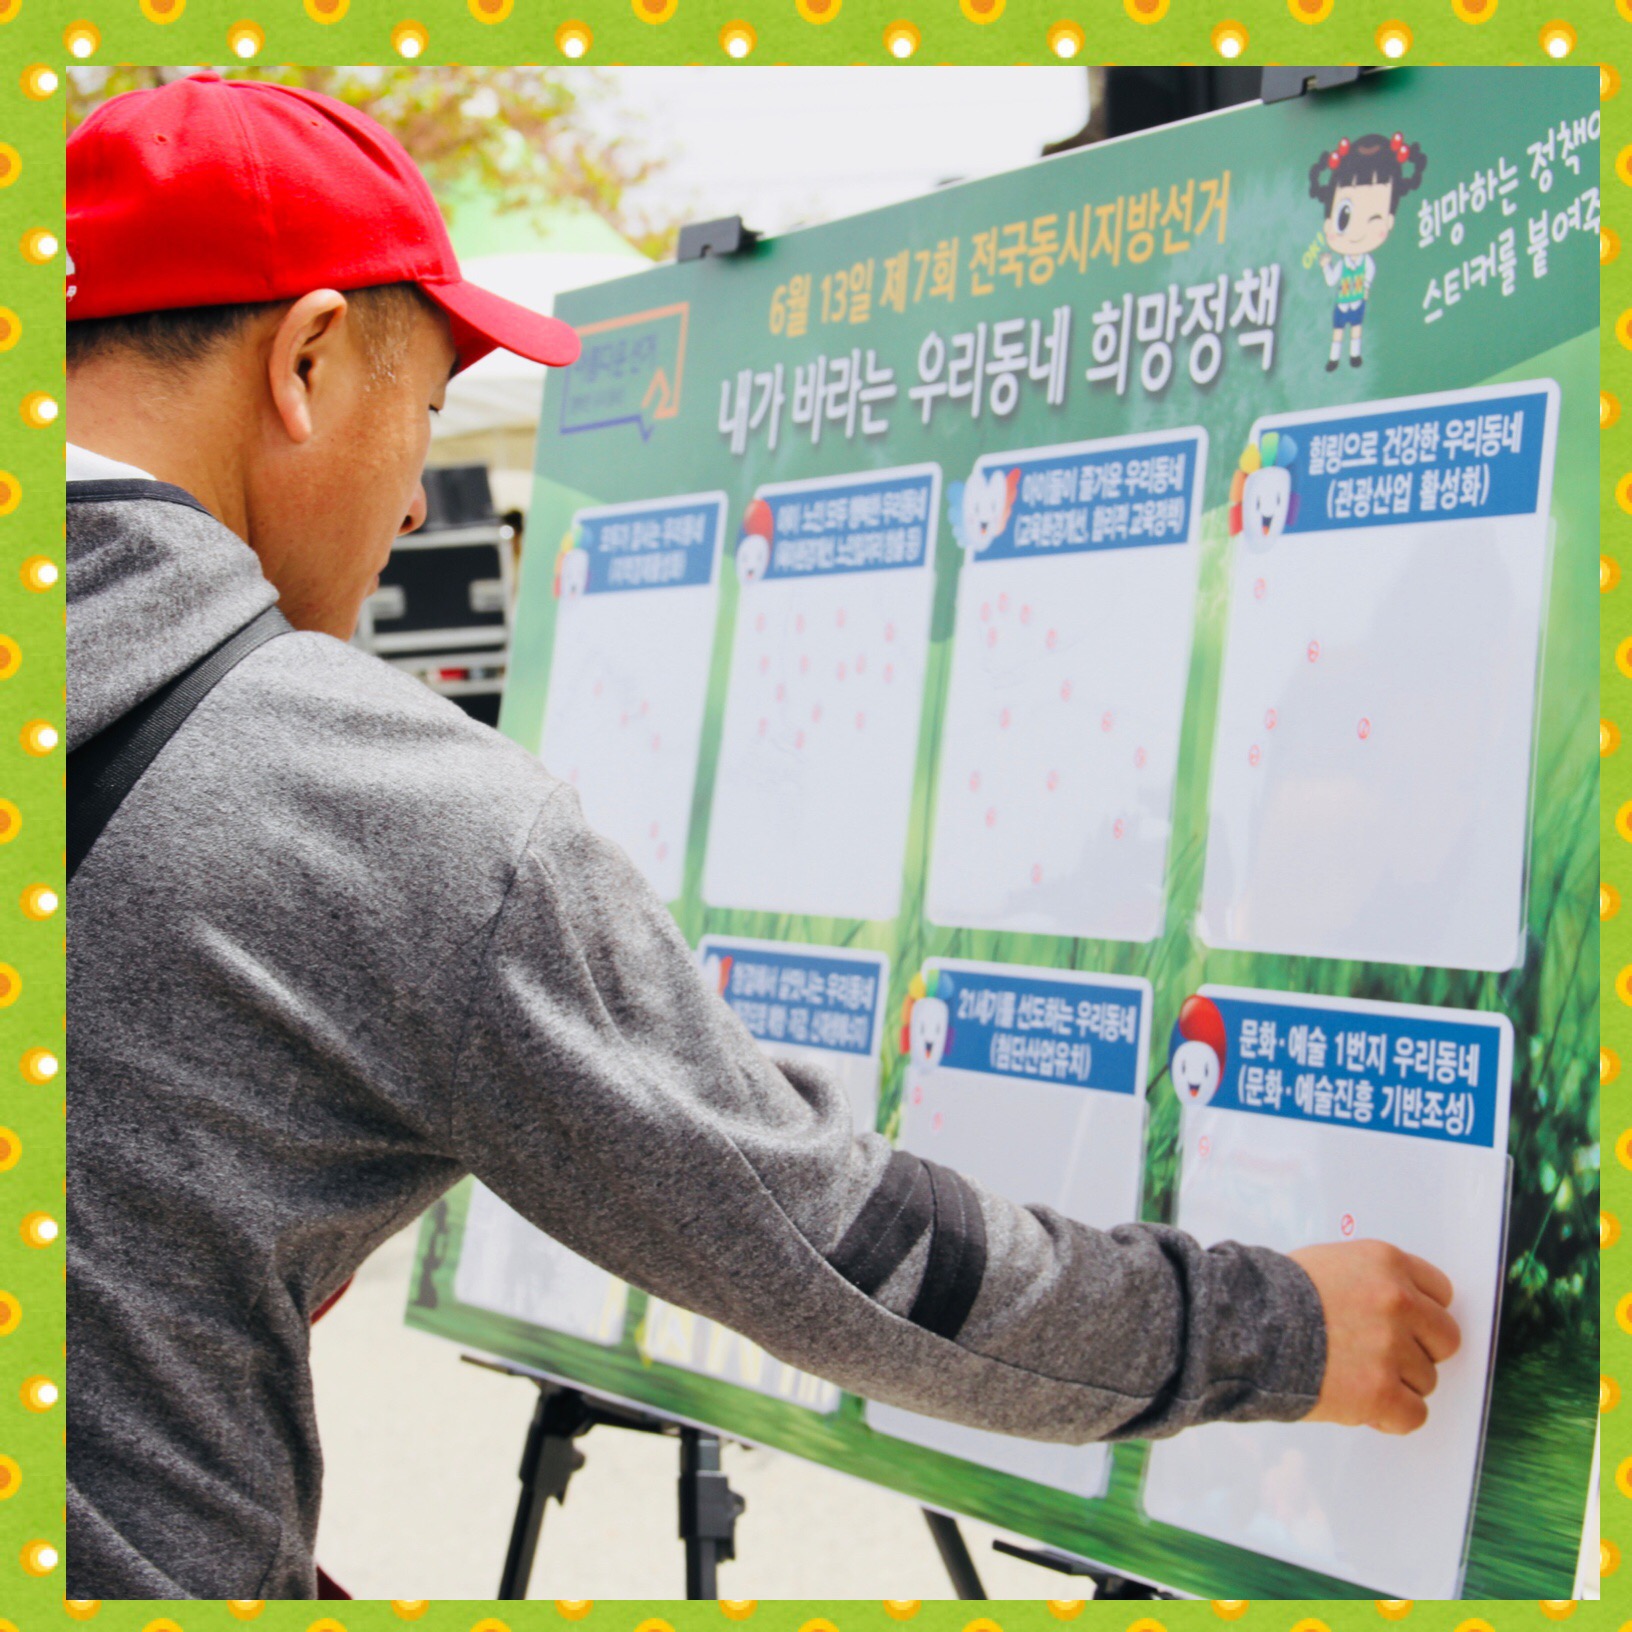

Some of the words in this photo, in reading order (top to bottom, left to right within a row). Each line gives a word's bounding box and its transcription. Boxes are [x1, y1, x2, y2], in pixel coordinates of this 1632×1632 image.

[1418, 156, 1519, 248] 희망하는
[769, 272, 812, 338] 6월
[819, 257, 875, 325] 13일
[968, 169, 1233, 298] 전국동시지방선거
[1422, 227, 1517, 325] 스티커를
[717, 362, 785, 456] 내가
[792, 347, 899, 446] 바라는
[907, 304, 1072, 425] 우리동네
[1085, 262, 1283, 397] 희망정책
[1308, 430, 1379, 476] 힐링으로
[1382, 420, 1441, 468] 건강한
[1442, 410, 1525, 461] 우리동네
[1125, 452, 1187, 497] 우리동네
[1326, 471, 1413, 519] (관광산업
[1418, 463, 1491, 512] 활성화)
[1074, 1000, 1138, 1044] 우리동네
[1333, 1030, 1388, 1076] 1번지
[1392, 1036, 1480, 1087] 우리동네
[1380, 1084, 1475, 1136] 기반조성)
